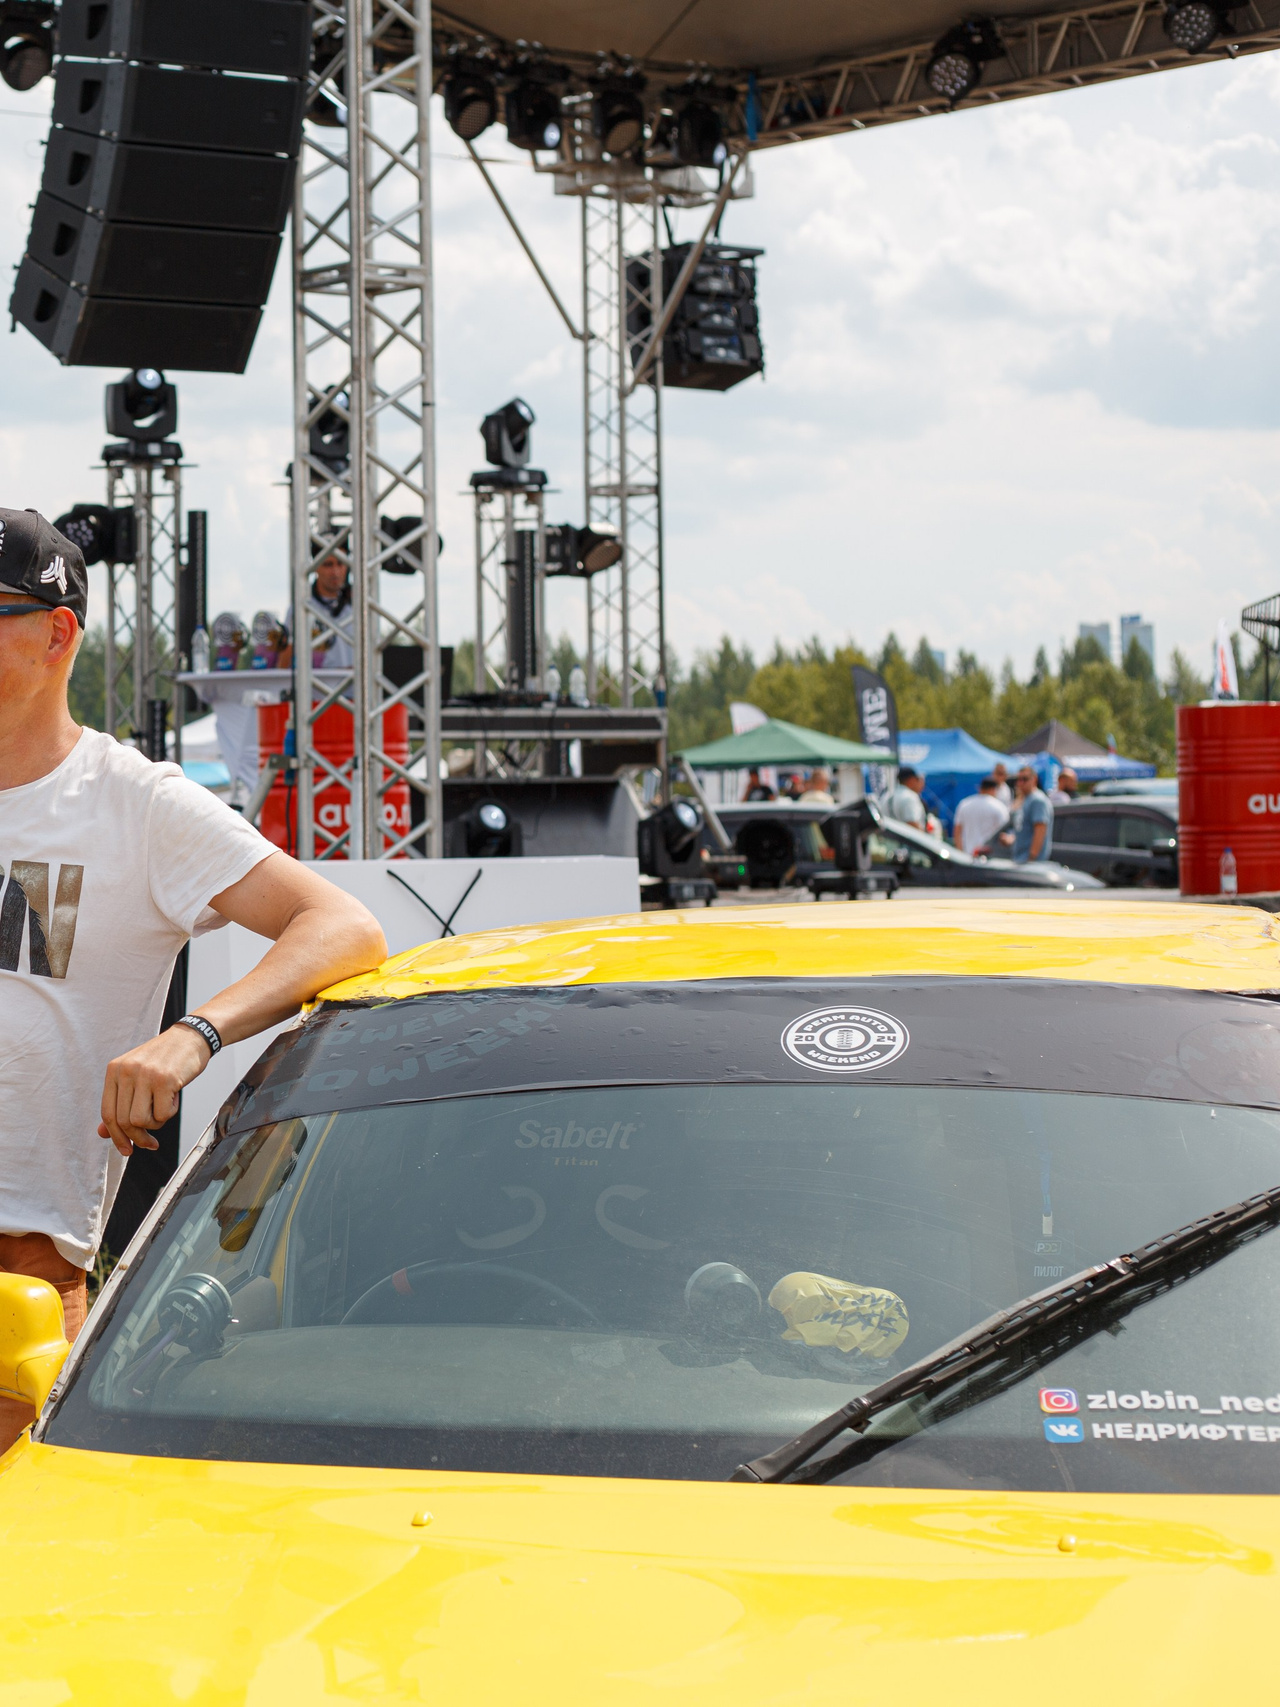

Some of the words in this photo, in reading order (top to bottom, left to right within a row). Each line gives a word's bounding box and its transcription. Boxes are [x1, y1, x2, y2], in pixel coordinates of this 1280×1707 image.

[803, 1014, 846, 1032] PERM
[849, 1014, 889, 1033] AUTO
[197, 1021, 220, 1051] AUTO
[876, 1035, 897, 1043] 24
[807, 1049, 882, 1065] WEEKEND
[514, 1119, 638, 1150] Sabelt
[552, 1156, 600, 1167] Titan
[1033, 1265, 1064, 1277] ПИЛОТ
[1086, 1390, 1280, 1415] zlobin_ned
[1091, 1422, 1280, 1443] НЕДРИФТЕР
